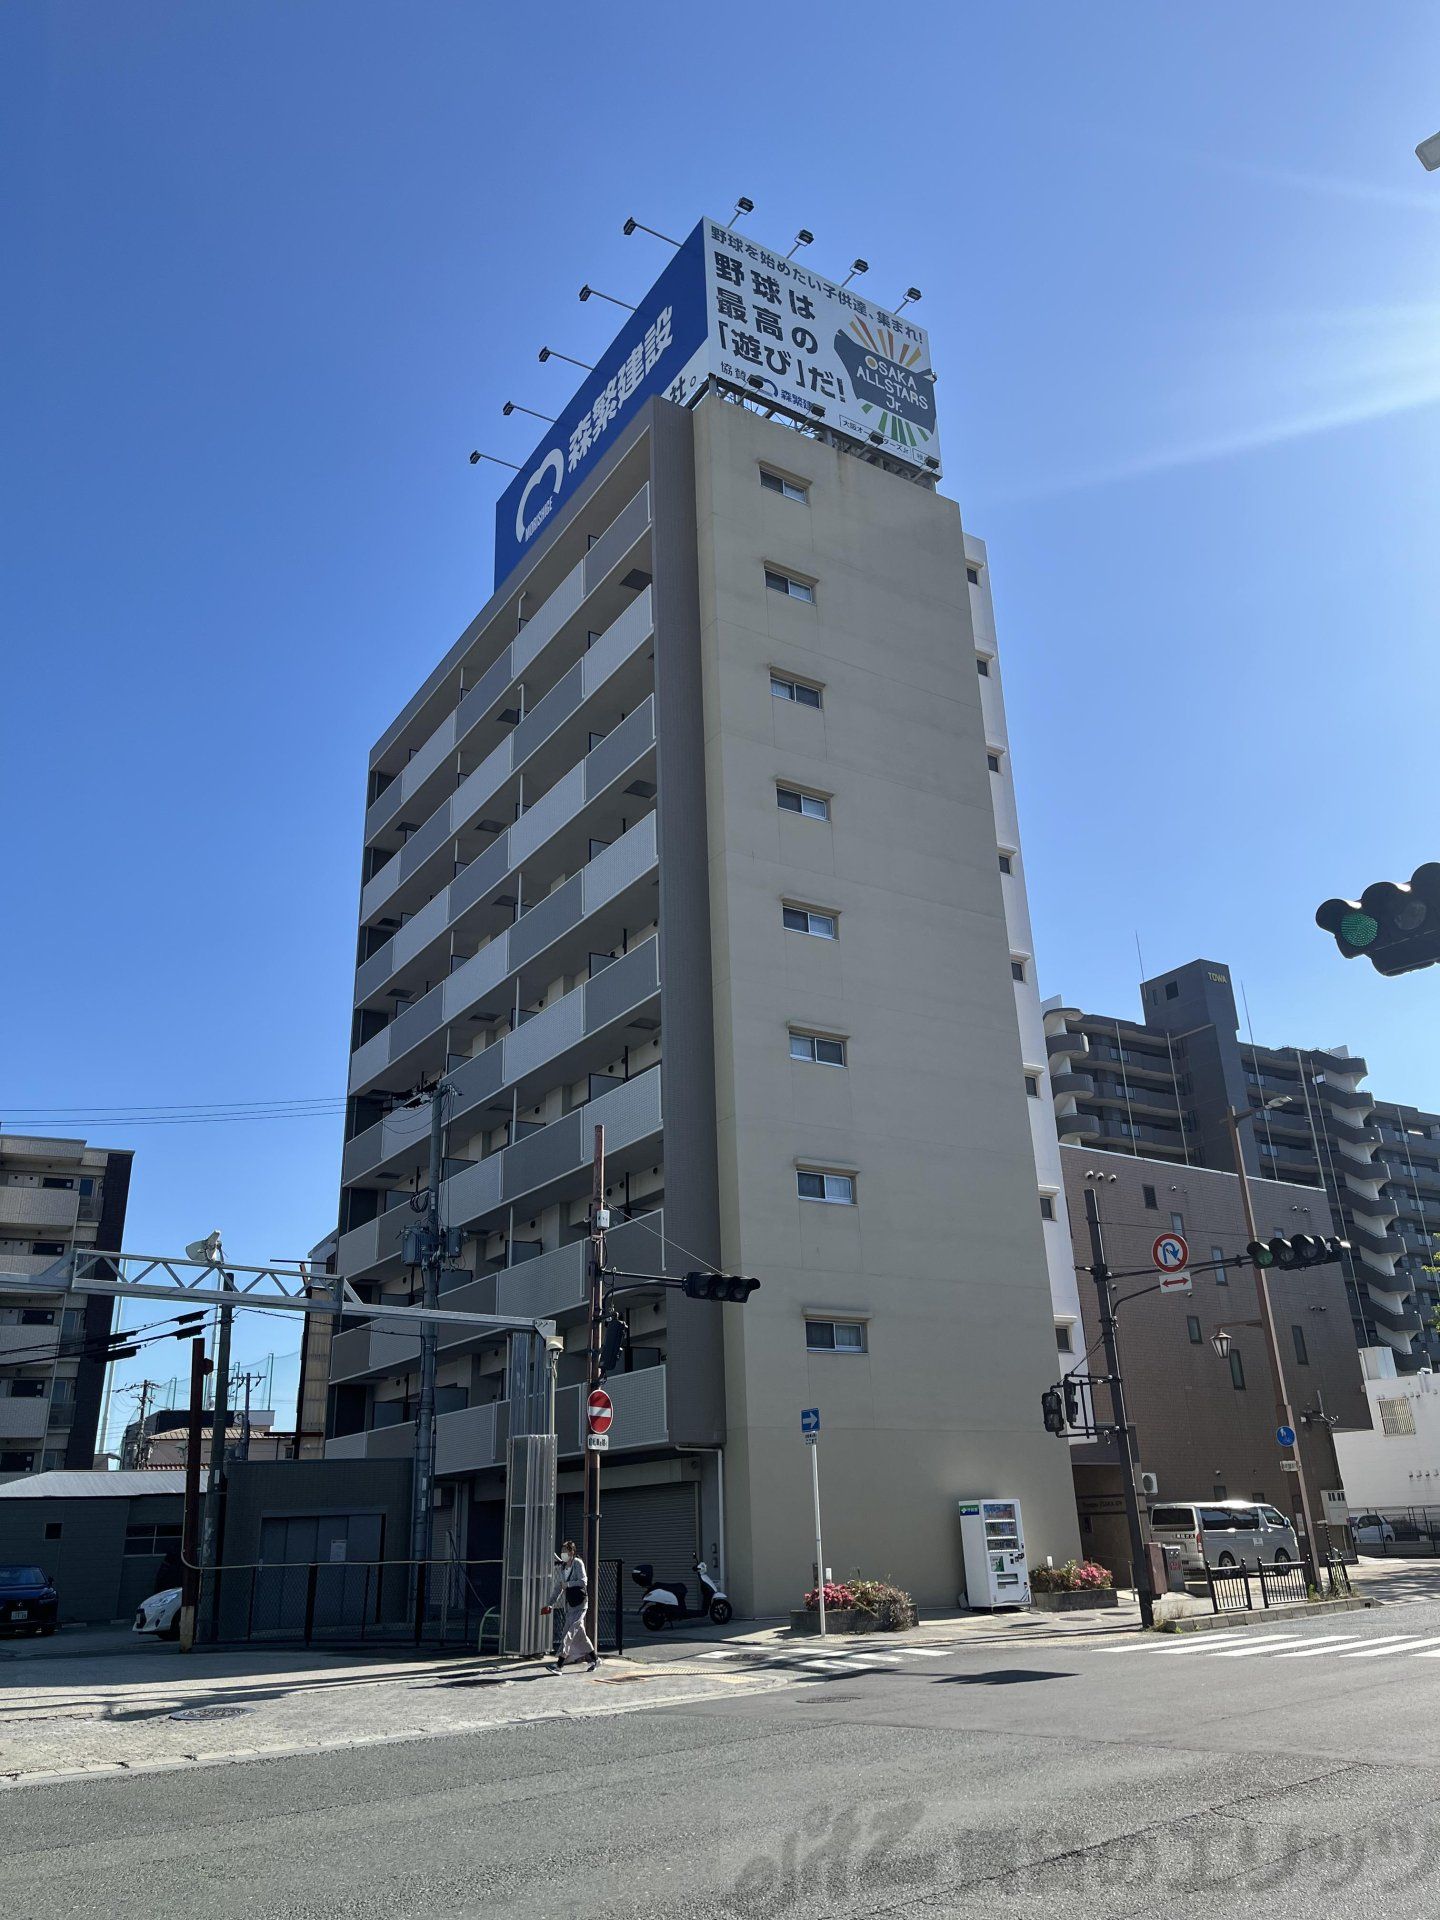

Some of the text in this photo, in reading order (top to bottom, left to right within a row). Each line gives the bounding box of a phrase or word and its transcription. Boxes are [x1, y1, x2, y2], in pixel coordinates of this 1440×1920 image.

[714, 251, 816, 320] 野球は
[716, 287, 818, 354] 最高の
[568, 305, 673, 474] 森繁建設
[856, 365, 928, 410] ALLSTARS
[865, 355, 917, 391] OSAKA
[886, 394, 903, 413] Jr.
[1207, 971, 1227, 983] TOWA
